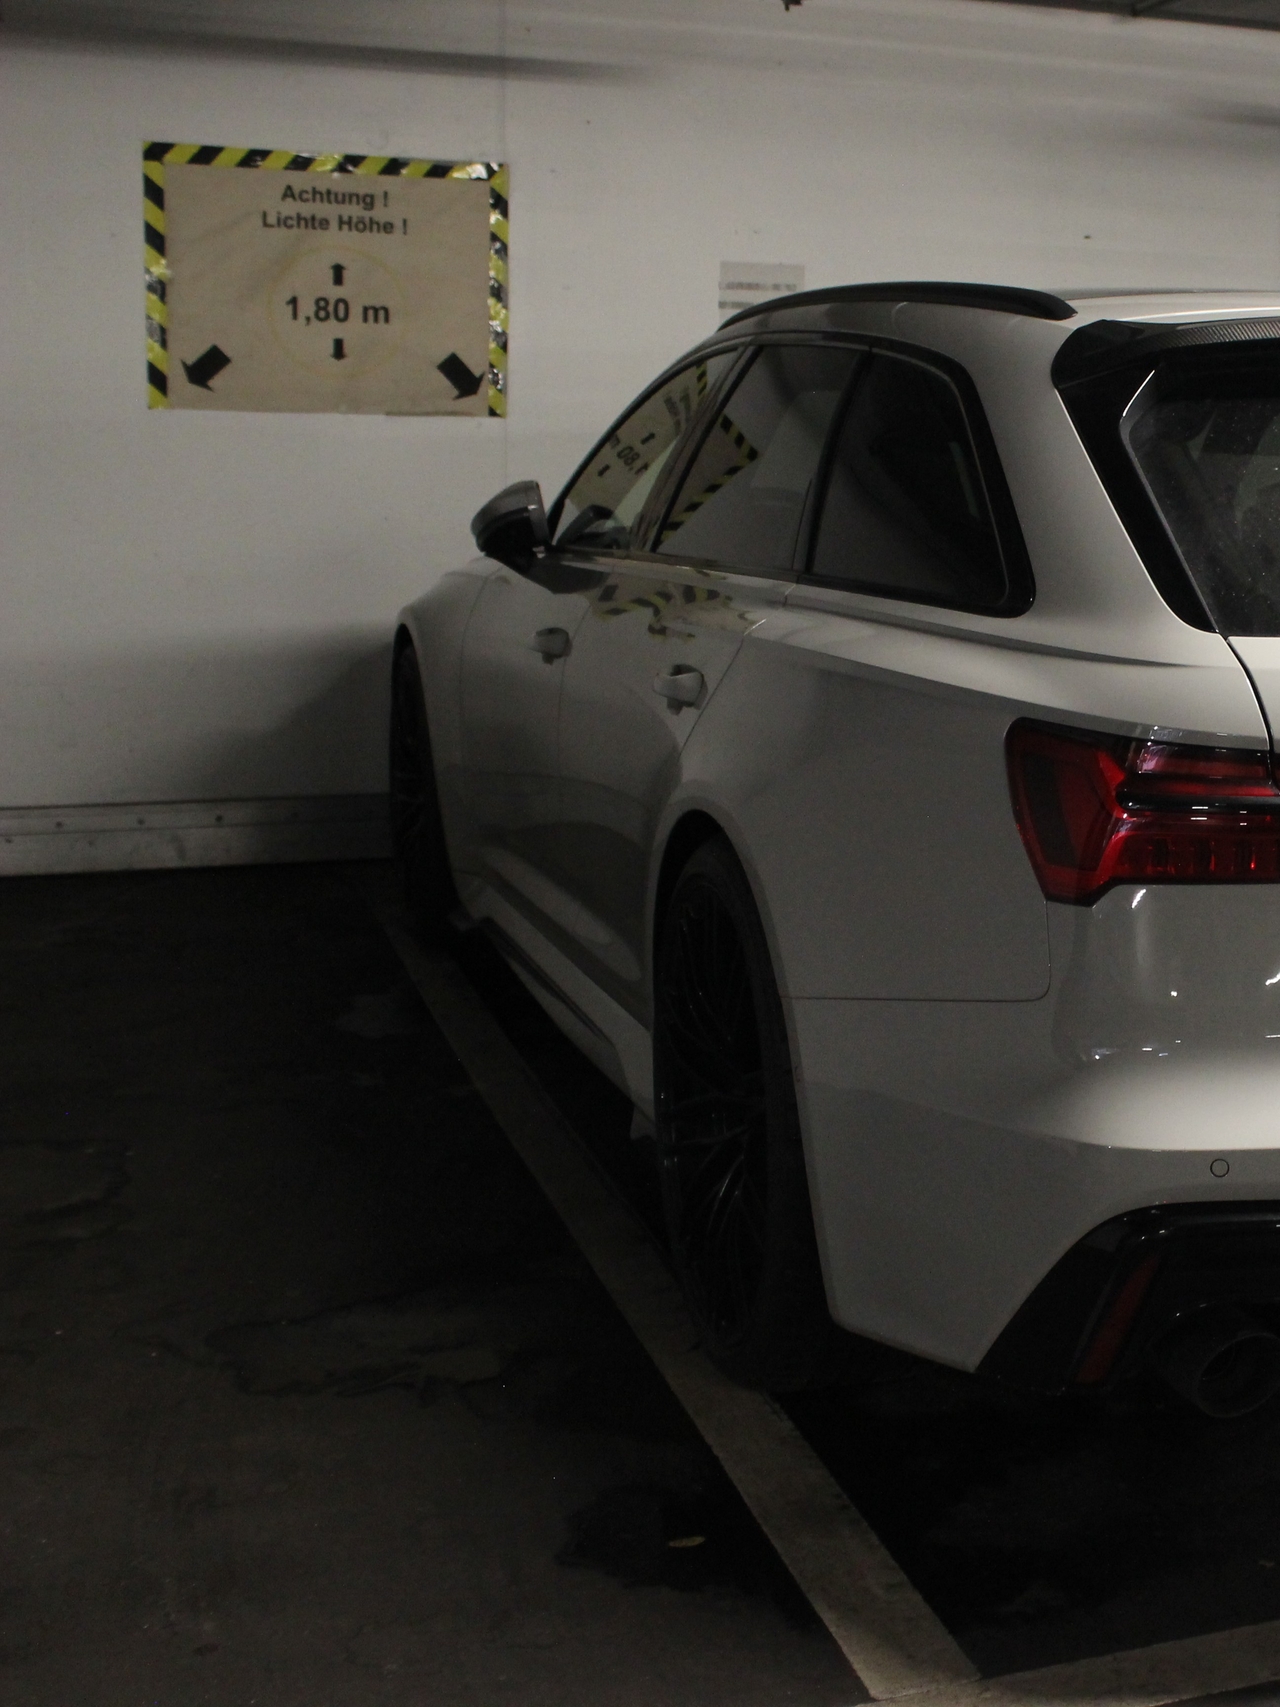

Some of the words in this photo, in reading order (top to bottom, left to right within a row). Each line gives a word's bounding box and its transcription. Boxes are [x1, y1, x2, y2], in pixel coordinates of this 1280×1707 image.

[281, 184, 375, 211] Achtung
[262, 210, 331, 231] Lichte
[338, 214, 394, 234] Höhe
[285, 296, 350, 326] 1,80
[362, 305, 390, 324] m
